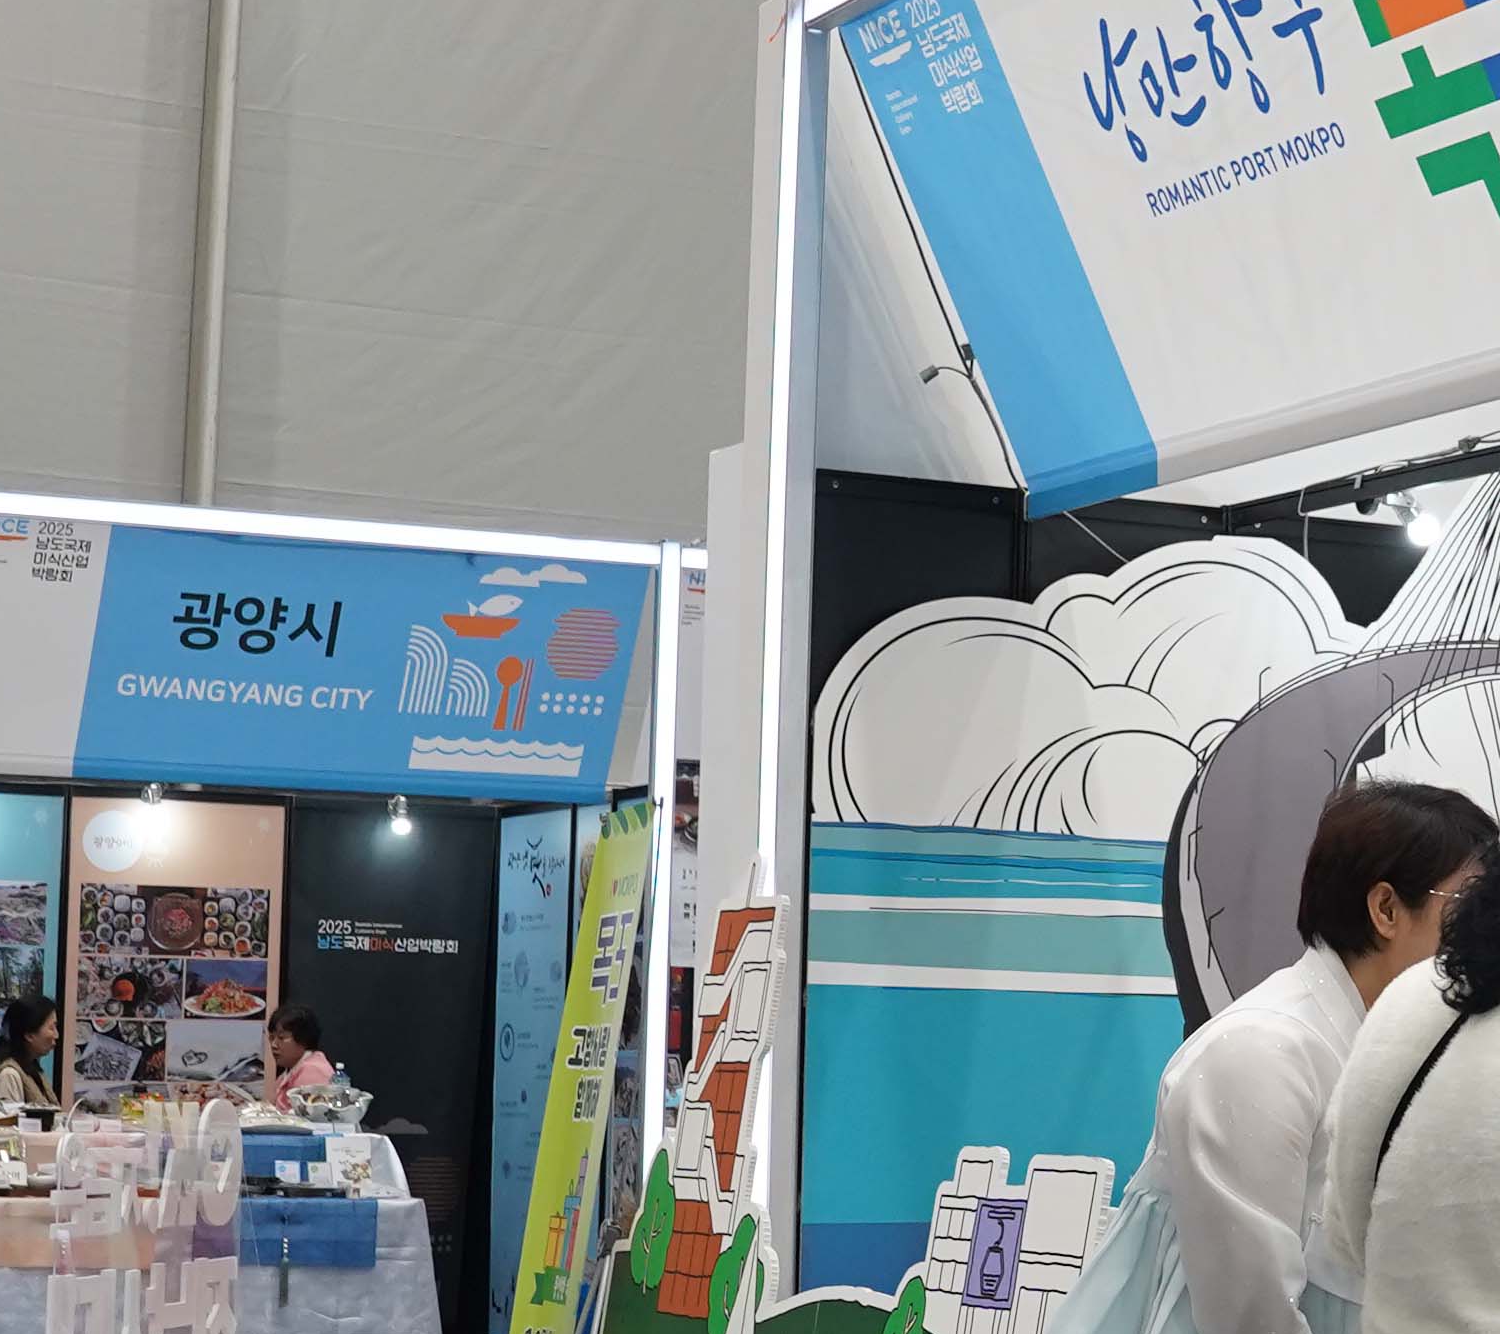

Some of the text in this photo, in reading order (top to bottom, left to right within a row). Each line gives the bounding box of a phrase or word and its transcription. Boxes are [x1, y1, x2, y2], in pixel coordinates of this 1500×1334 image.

[858, 9, 906, 53] NICE
[916, 12, 971, 58] 남도국제
[928, 43, 983, 87] 미식산업
[940, 79, 983, 114] 박람회
[1146, 122, 1346, 217] ROMANTIC PORT MOKPO
[35, 537, 92, 554] 남도국제
[38, 521, 74, 536] 2025
[31, 567, 73, 582] 박람회
[33, 551, 89, 569] 미식산업
[172, 591, 342, 658] 광양시
[117, 673, 374, 711] GWANGYANG CITY
[318, 919, 351, 935] 2025
